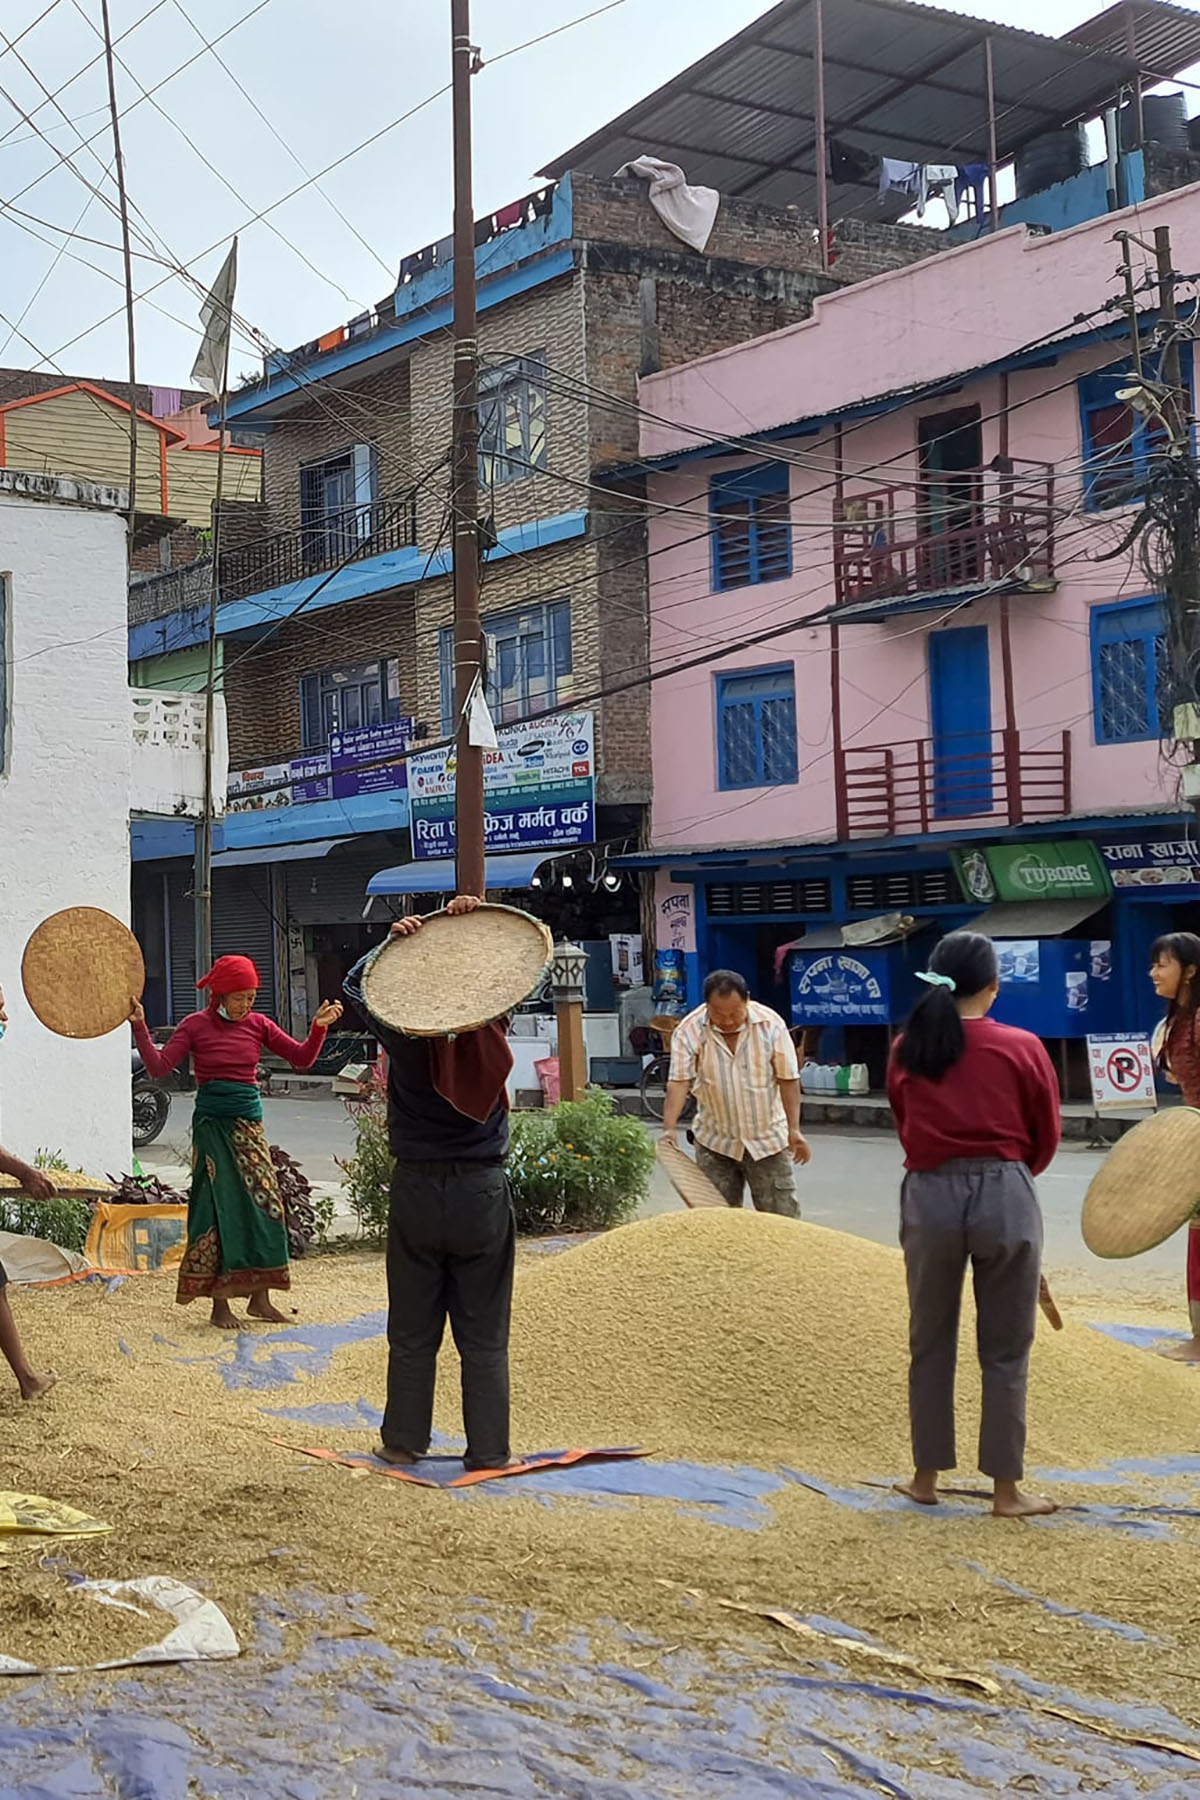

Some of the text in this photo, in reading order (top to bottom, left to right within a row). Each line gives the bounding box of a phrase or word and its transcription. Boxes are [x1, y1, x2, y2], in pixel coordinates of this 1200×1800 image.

[529, 719, 558, 729] AUCMA
[416, 819, 445, 839] रिता
[518, 806, 557, 828] मर्मत
[561, 801, 590, 824] वर्क
[1101, 840, 1198, 860] राना खाजा
[1019, 863, 1092, 884] TUBORG
[798, 955, 833, 994] सपना
